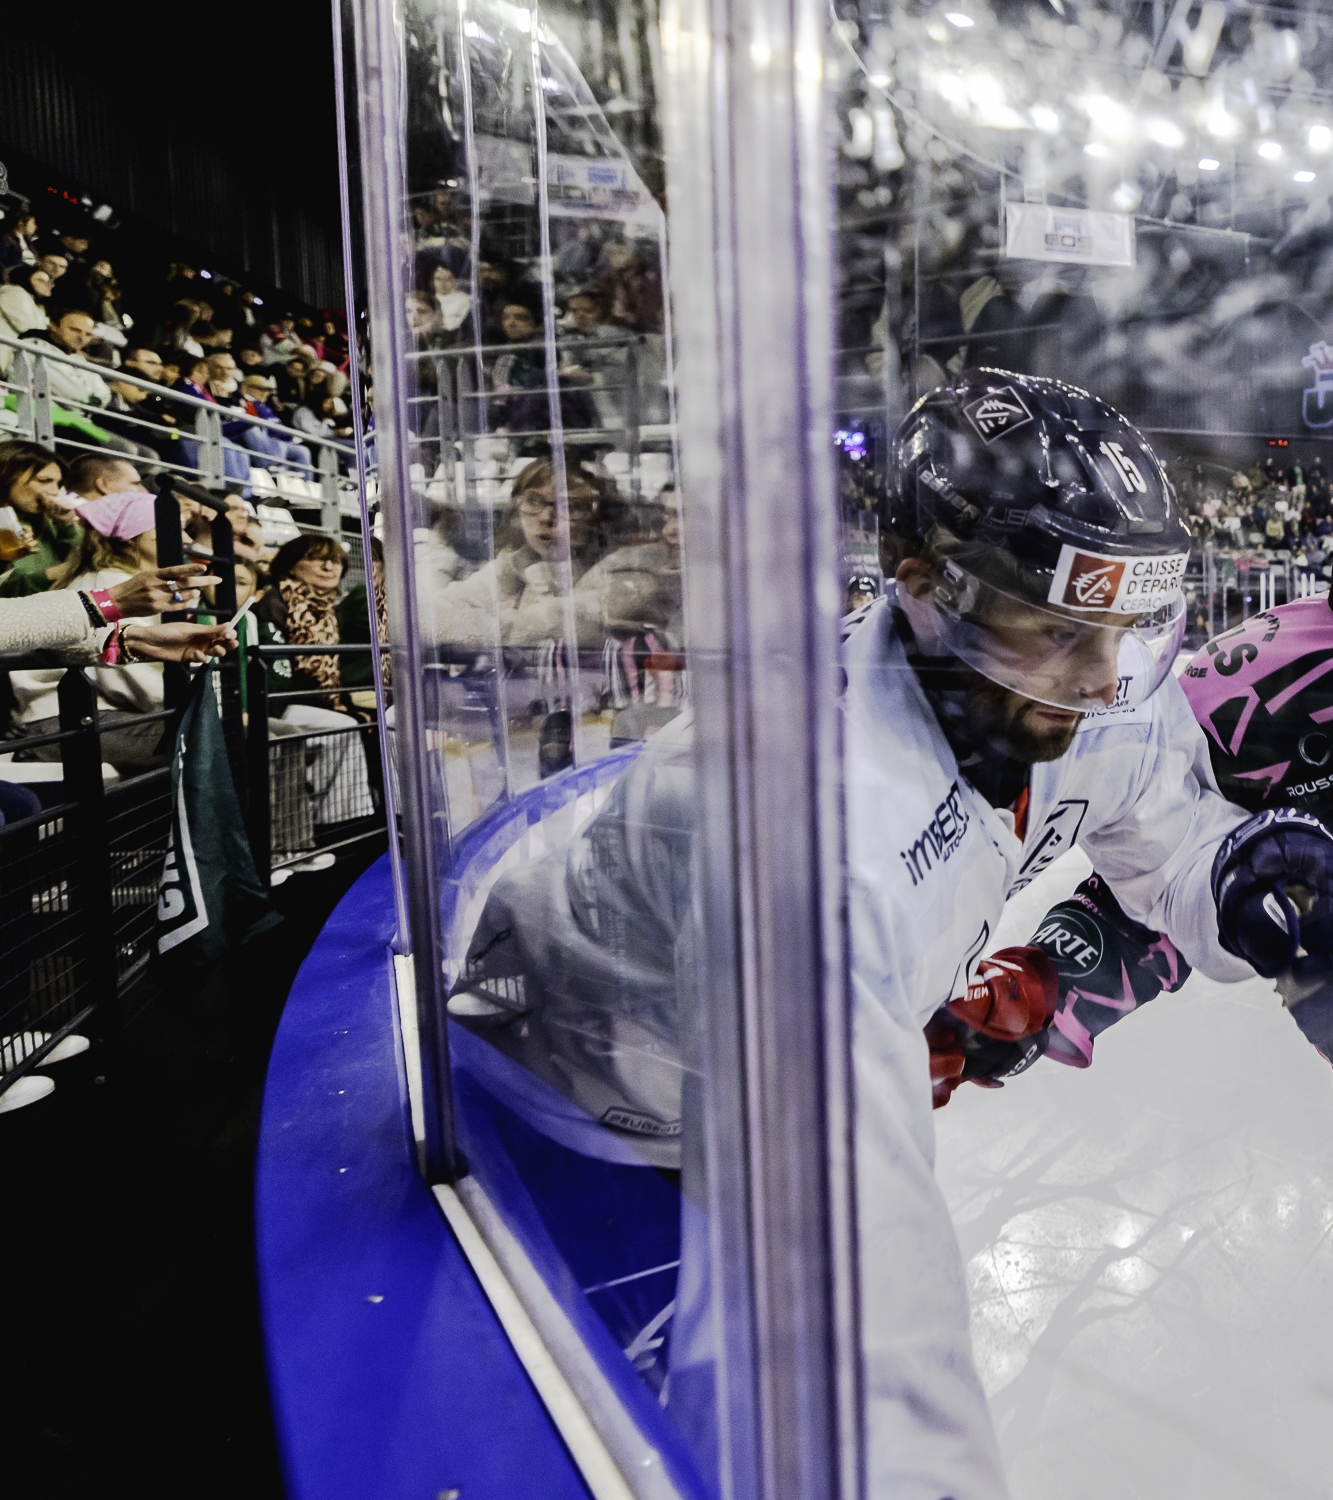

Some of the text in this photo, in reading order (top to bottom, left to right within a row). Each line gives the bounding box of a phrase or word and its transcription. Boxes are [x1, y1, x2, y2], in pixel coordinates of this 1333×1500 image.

[1099, 440, 1148, 494] 15
[1132, 557, 1184, 577] CAISSE
[1033, 922, 1099, 968] ARTE
